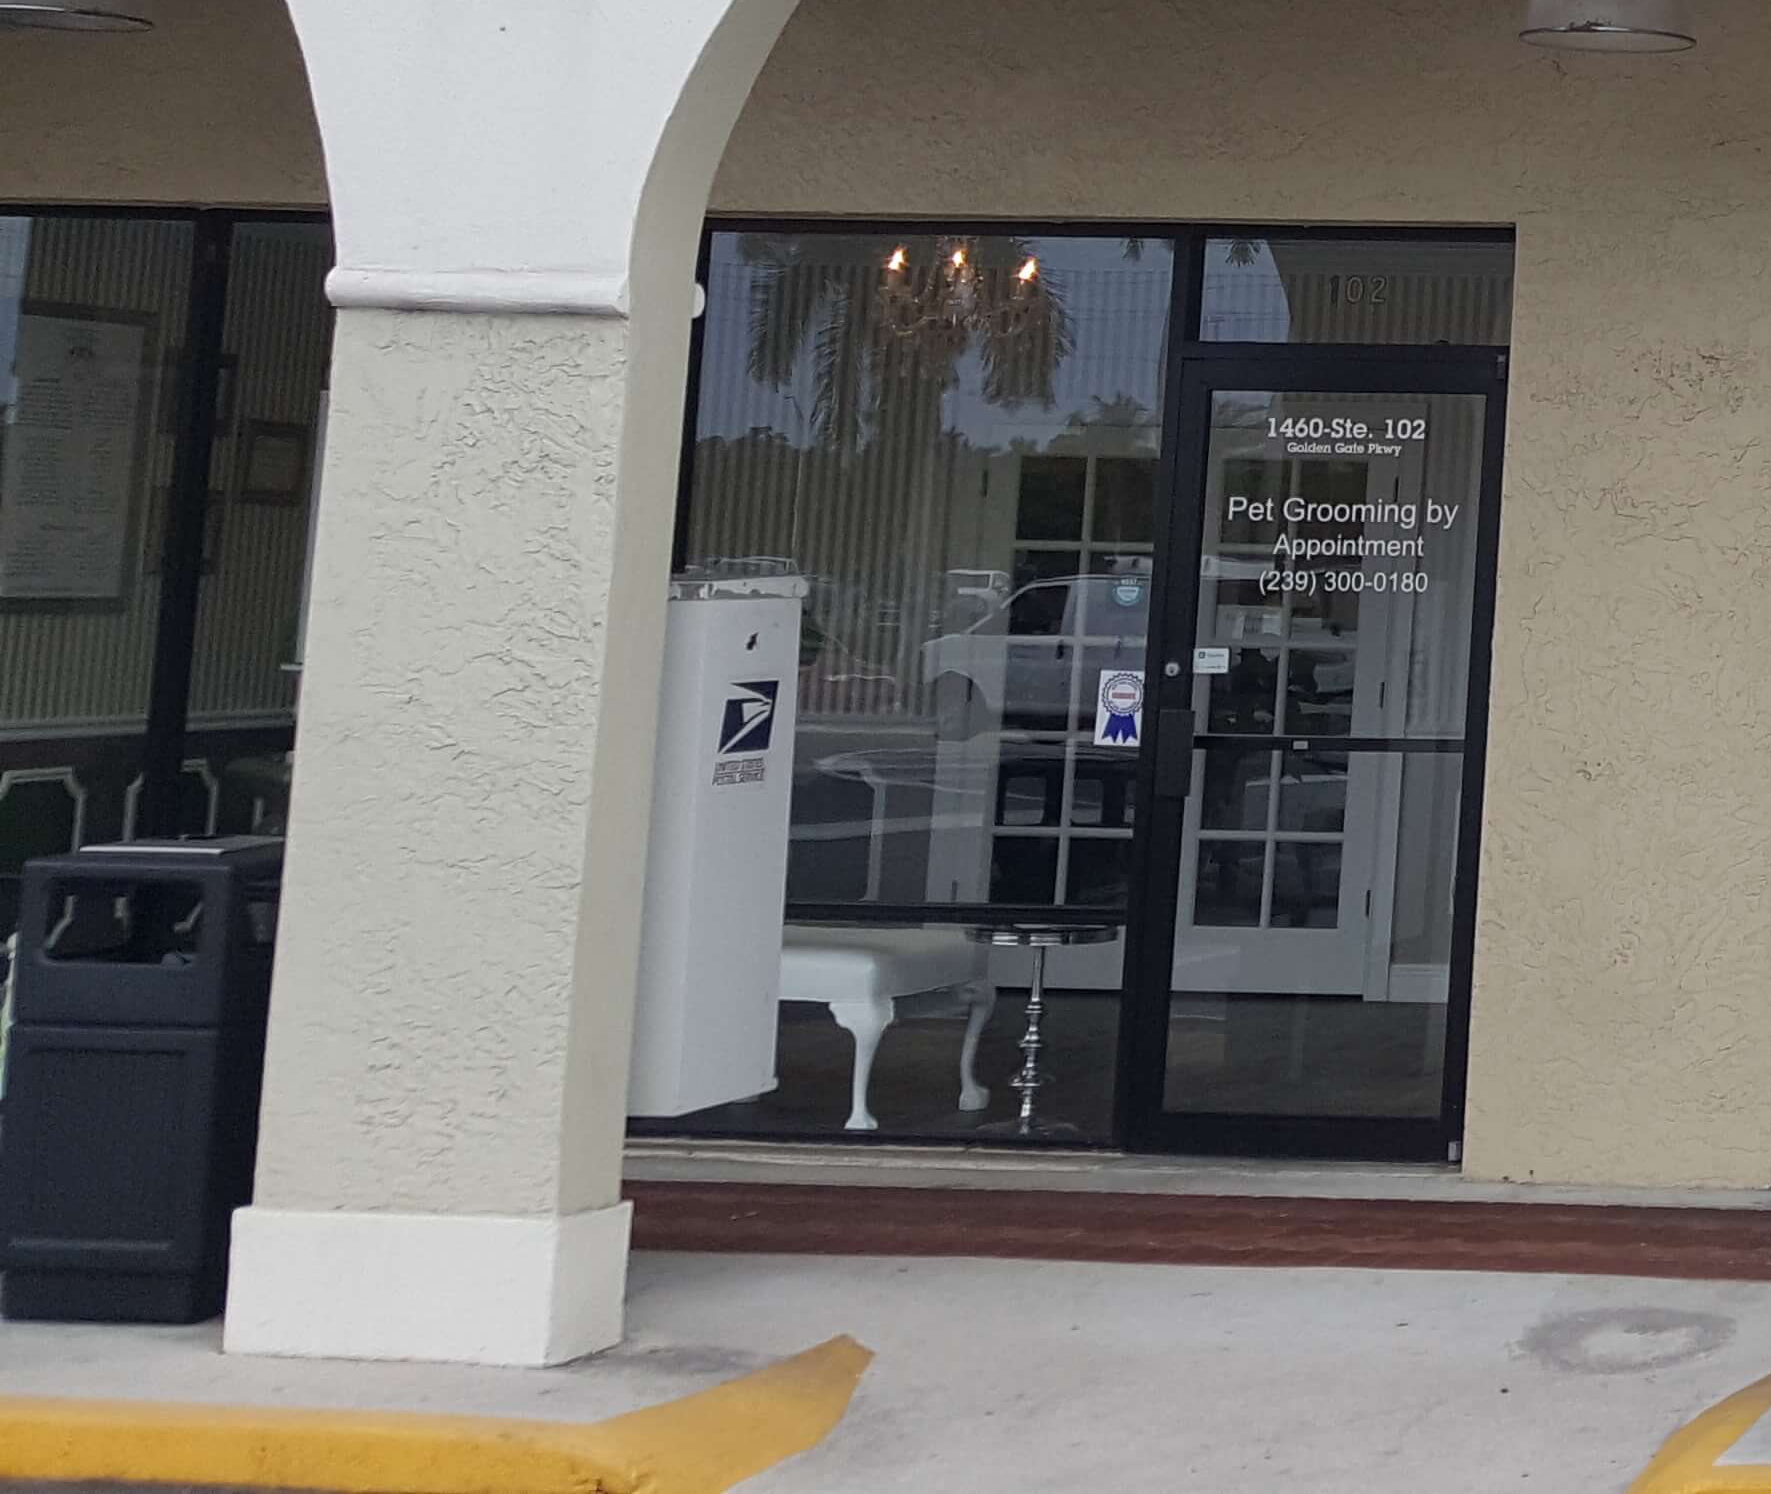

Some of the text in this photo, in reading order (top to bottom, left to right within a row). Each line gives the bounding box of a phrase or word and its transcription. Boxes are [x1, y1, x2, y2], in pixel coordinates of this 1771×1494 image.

[1329, 275, 1388, 305] 102
[1267, 417, 1426, 440] 1460-Ste. 102
[1287, 442, 1402, 457] Golden Gate Pkwy
[1228, 497, 1459, 529] Pet Grooming by
[1273, 534, 1424, 559] Appointment
[1258, 570, 1428, 597] (239) 300-0180
